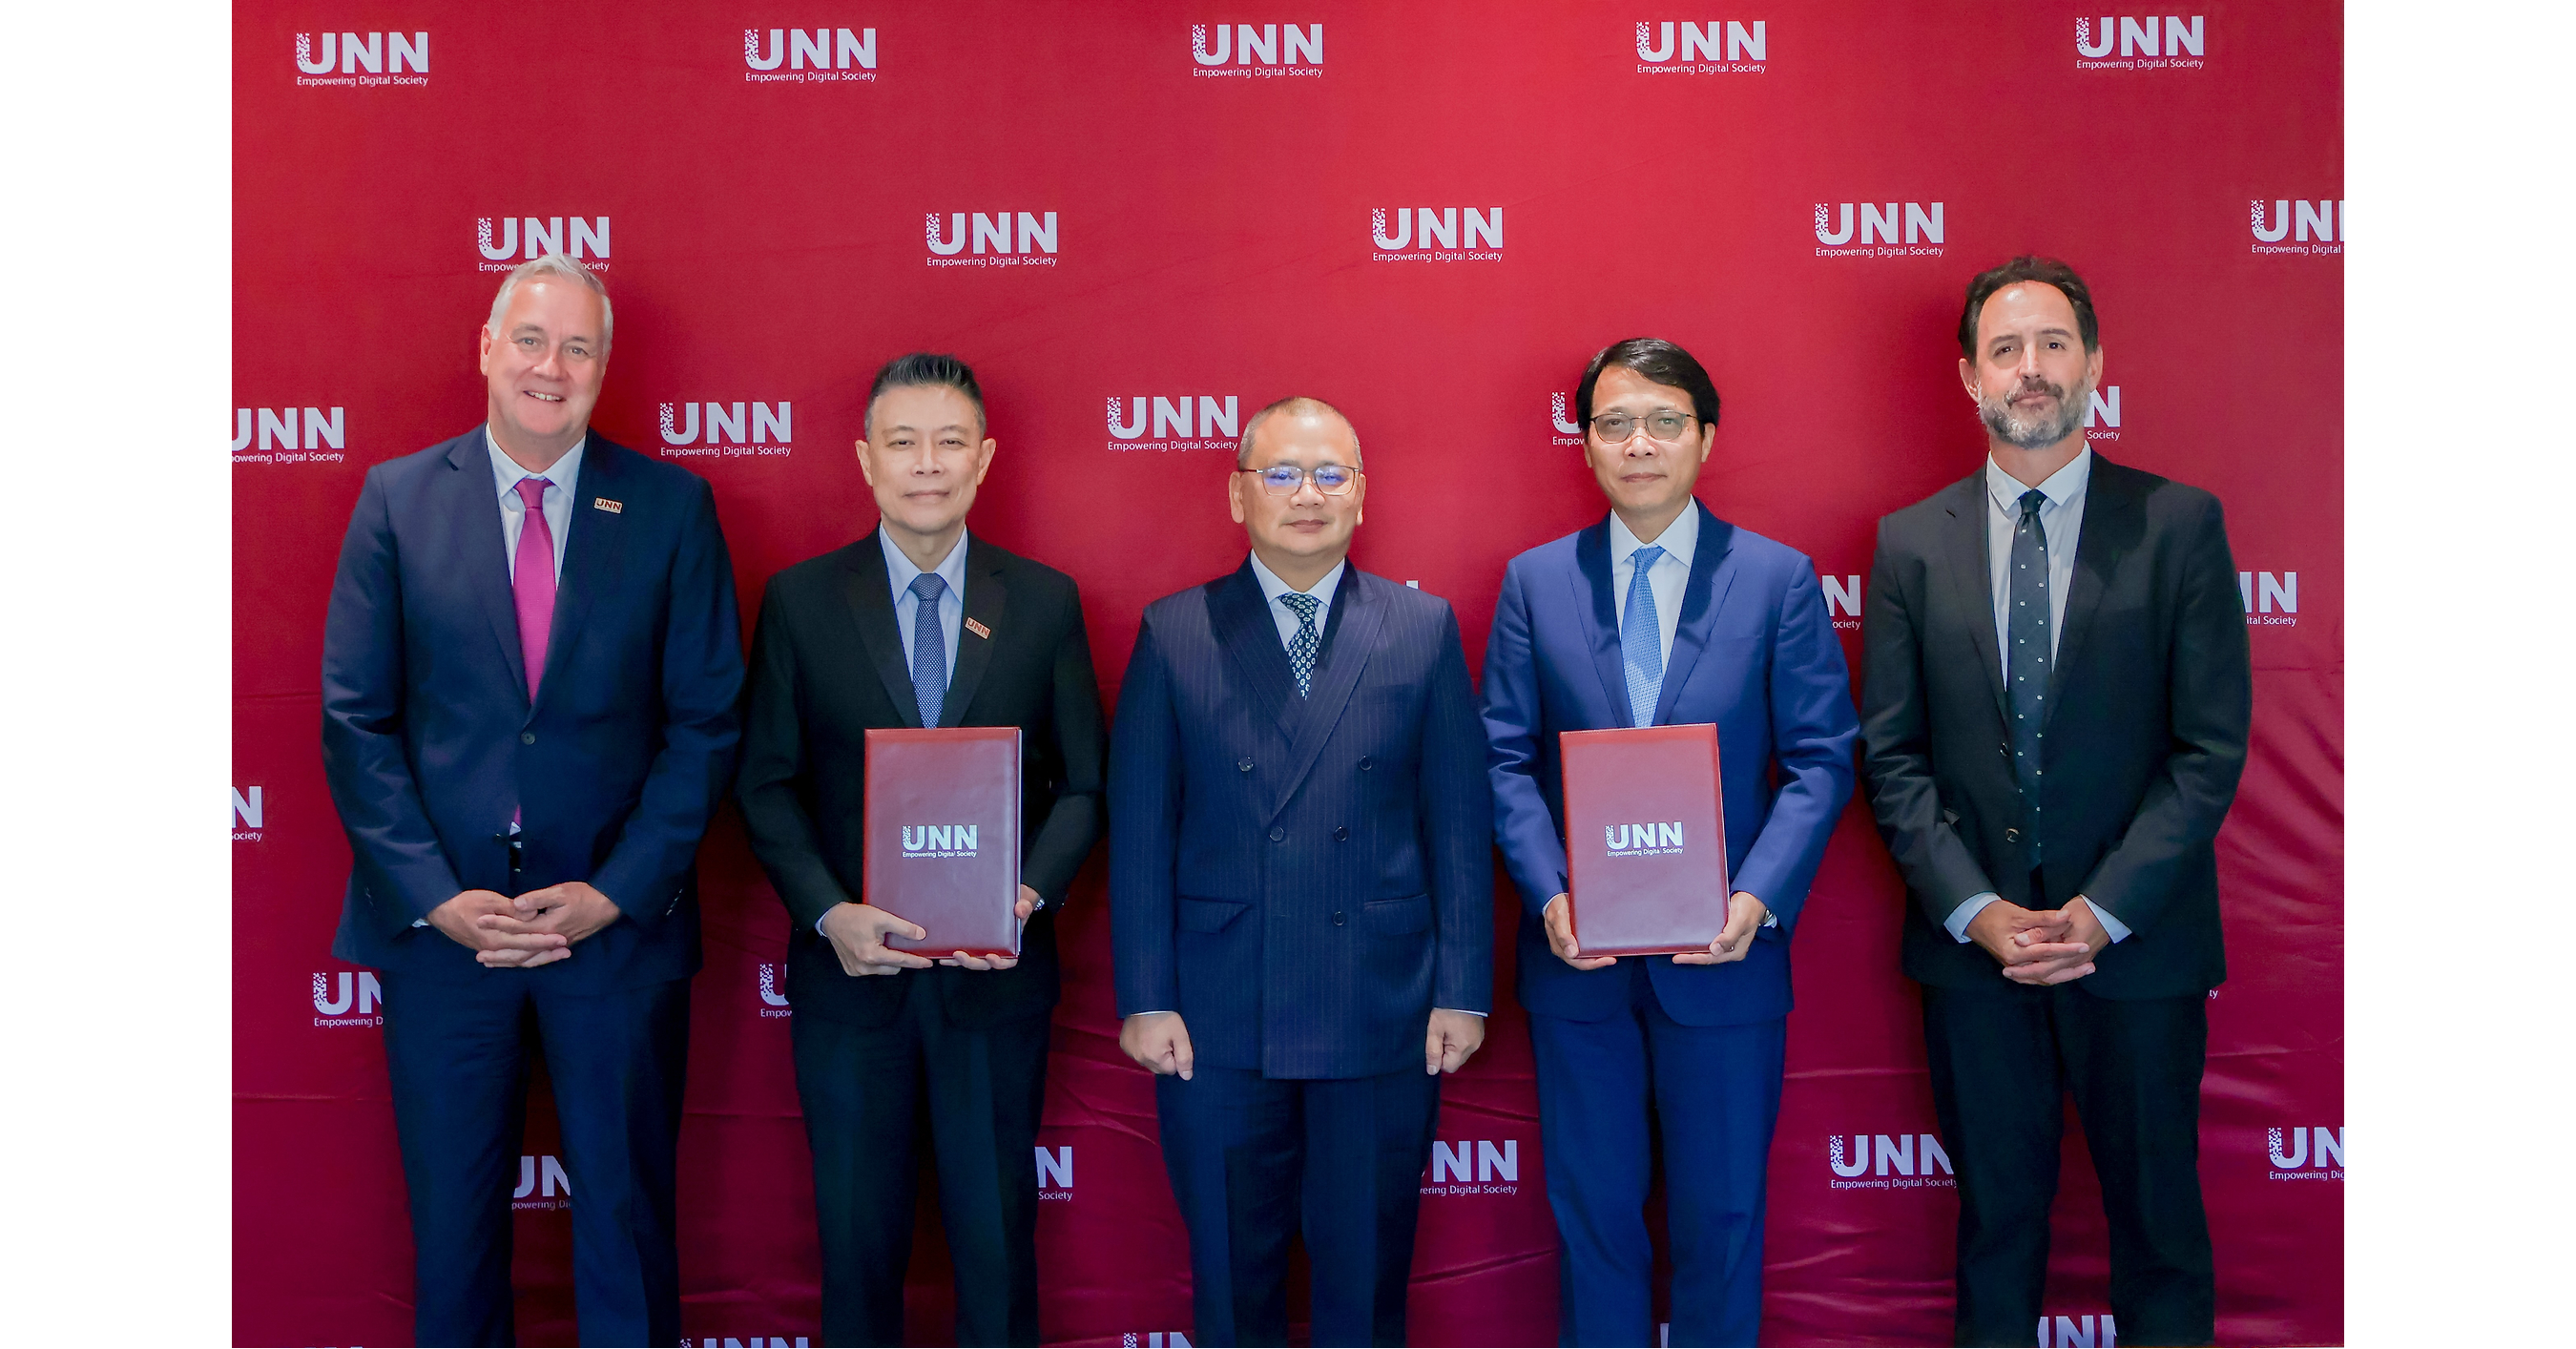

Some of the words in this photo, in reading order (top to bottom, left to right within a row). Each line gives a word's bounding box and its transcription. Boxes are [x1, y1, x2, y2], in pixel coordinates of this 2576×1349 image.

[1635, 20, 1767, 63] UNN
[2075, 15, 2205, 58] UNN
[744, 27, 877, 72] UNN
[1192, 23, 1324, 67] UNN
[296, 31, 429, 75] UNN
[1636, 64, 1695, 75] Empowering
[1698, 63, 1729, 75] Digital
[1731, 63, 1767, 75] Society
[2076, 59, 2134, 71] Empowering
[2136, 59, 2168, 71] Digital
[2170, 58, 2204, 71] Society
[745, 72, 804, 83] Empowering
[807, 71, 840, 83] Digital
[841, 71, 877, 83] Society
[1193, 67, 1252, 78] Empowering
[1255, 67, 1286, 78] Digital
[1288, 67, 1323, 78] Society
[296, 76, 357, 88] Empowering
[359, 75, 391, 87] Digital
[393, 74, 429, 87] Society
[1815, 201, 1944, 246] UNN
[2251, 199, 2344, 243] UN
[925, 211, 1058, 256] UNN
[1371, 206, 1504, 251] UNN
[477, 216, 611, 260] UNN
[1372, 252, 1432, 263] Empowering
[1435, 251, 1465, 262] Digital
[1467, 250, 1504, 262] Society
[1815, 247, 1875, 259] Empowering
[1877, 246, 1907, 259] Digital
[1909, 246, 1944, 259] Society
[2251, 244, 2310, 257] Empowering
[2312, 243, 2341, 256] Digital
[581, 260, 610, 273] ociety
[926, 257, 987, 268] Empowering
[988, 257, 1020, 268] Digital
[1022, 256, 1058, 268] Society
[659, 401, 792, 446] UNN
[1106, 395, 1239, 440] UNN
[2086, 429, 2121, 442] Society
[660, 446, 720, 458] Empowering
[723, 446, 755, 458] Digital
[757, 445, 792, 458] Society
[1107, 441, 1168, 453] Empowering
[1170, 441, 1201, 452] Digital
[1203, 440, 1239, 452] Society
[232, 453, 273, 465] owering
[275, 452, 307, 465] Digital
[308, 451, 344, 464] Society
[595, 499, 621, 510] UNN
[966, 618, 989, 636] UNN
[1832, 619, 1861, 631] ociety
[2246, 615, 2261, 625] ital
[2262, 615, 2297, 628] Society
[902, 824, 978, 851] UNN
[1604, 820, 1684, 850] UNN
[1607, 847, 1642, 858] Empowering
[1662, 846, 1684, 855] Society
[312, 971, 383, 1016] UN
[314, 1017, 373, 1029] Empowering
[2268, 1126, 2344, 1169] UN
[1421, 1139, 1518, 1183] NN
[2269, 1170, 2328, 1182] Empowering
[1449, 1184, 1481, 1197] Digital
[1483, 1184, 1518, 1195] Society
[1830, 1178, 1890, 1191] Empowering
[1892, 1177, 1922, 1190] Digital
[1038, 1191, 1073, 1202] Society
[511, 1201, 556, 1212] powering
